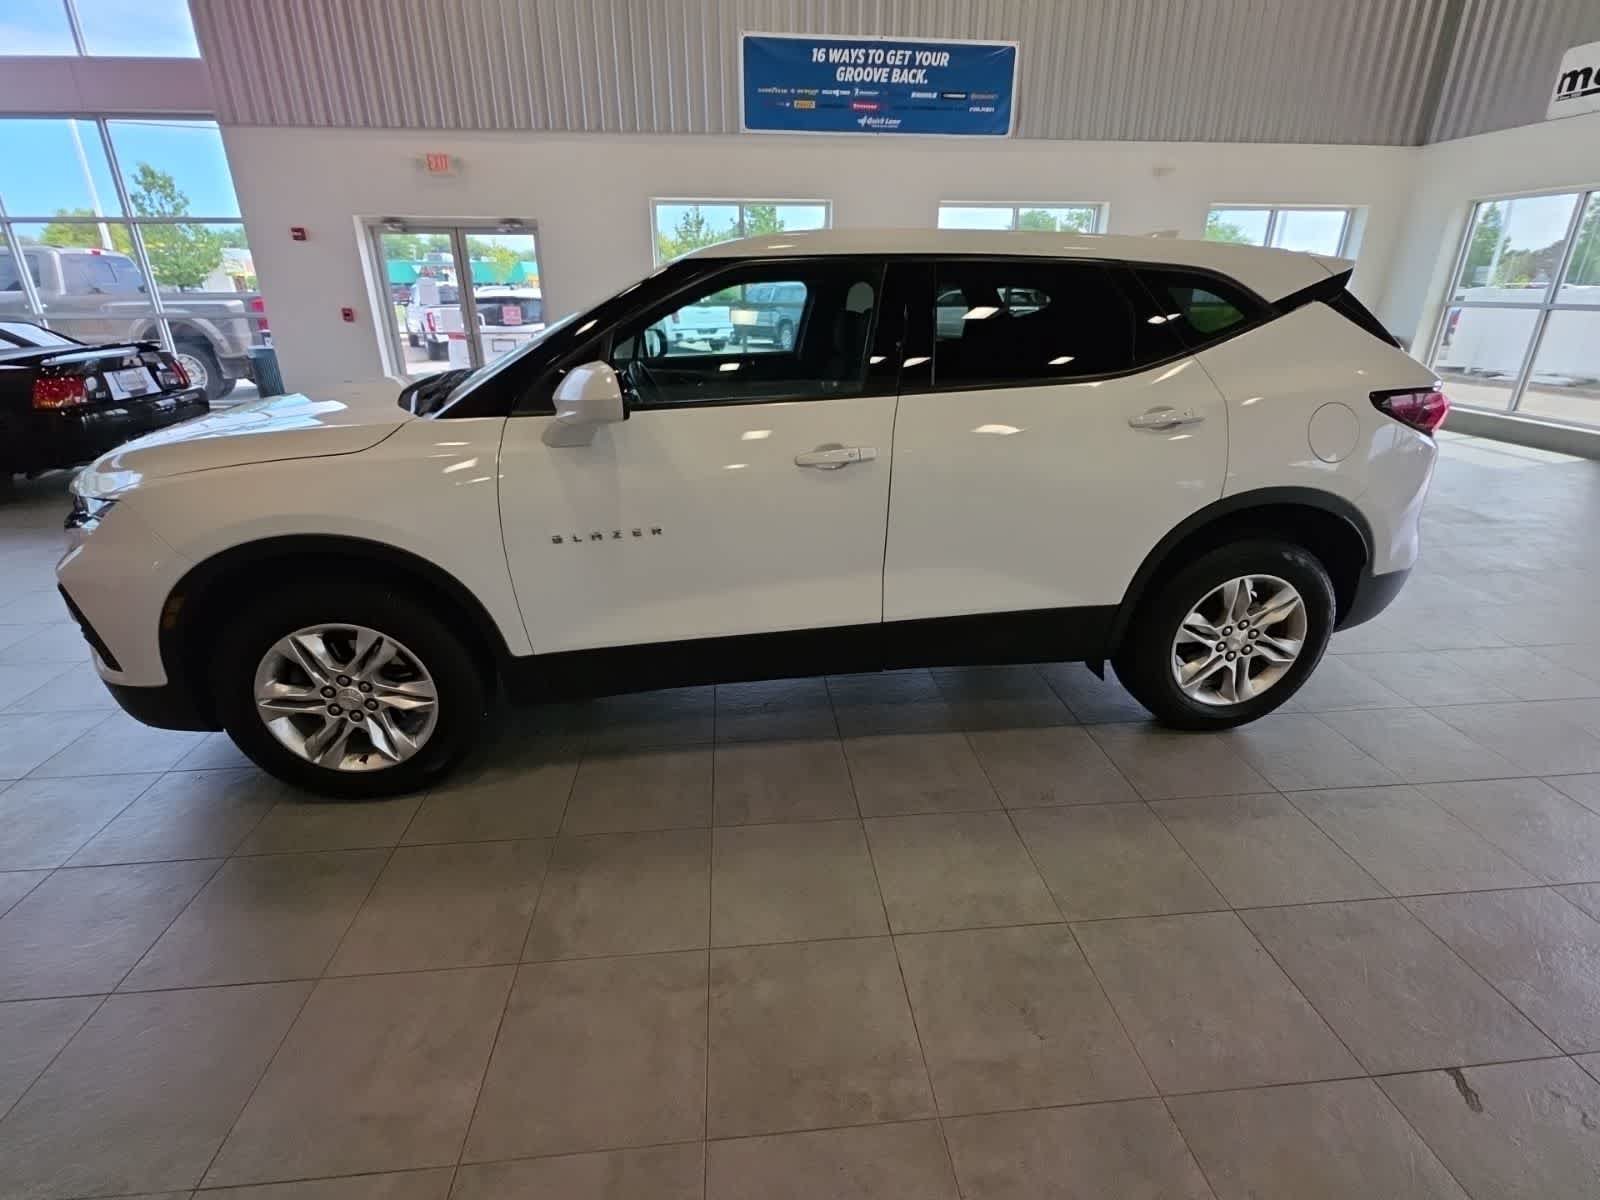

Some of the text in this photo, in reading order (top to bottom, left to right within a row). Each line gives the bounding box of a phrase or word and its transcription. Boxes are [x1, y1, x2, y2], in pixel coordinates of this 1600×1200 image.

[812, 47, 950, 67] 16 WAYS TO GET YOUR
[836, 66, 929, 85] GROOVE BACK.
[426, 153, 448, 170] EXIT
[551, 527, 663, 544] BLAZER
